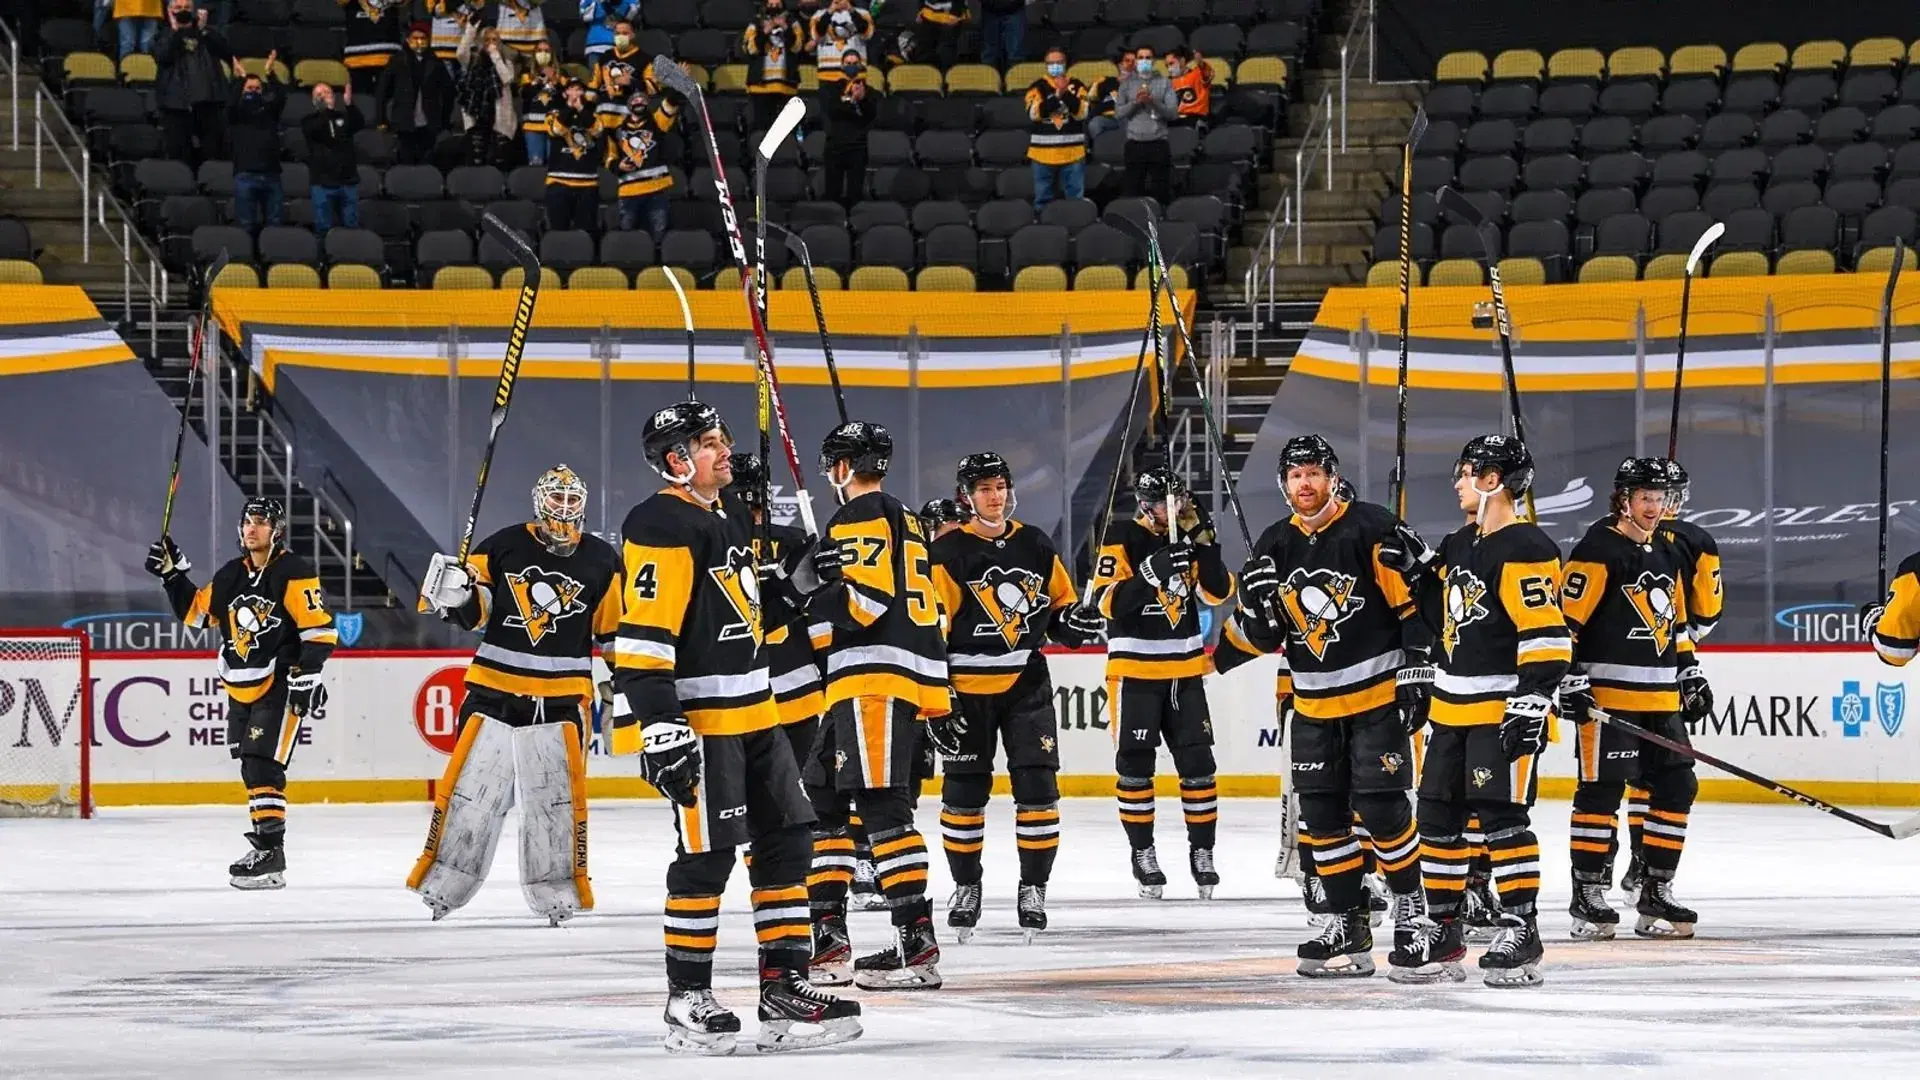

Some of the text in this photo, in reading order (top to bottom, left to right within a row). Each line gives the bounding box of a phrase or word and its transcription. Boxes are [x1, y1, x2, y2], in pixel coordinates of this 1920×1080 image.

[714, 178, 749, 267] CCM
[756, 237, 766, 310] CCM
[1490, 266, 1509, 337] BAUER
[495, 286, 535, 406] WARRIOR
[876, 458, 888, 471] 57
[1682, 500, 1919, 528] OPLES
[841, 536, 888, 568] 57
[1098, 555, 1118, 578] 8
[633, 563, 658, 600] 4
[1563, 571, 1588, 600] 9
[87, 621, 222, 650] HIGHM
[1793, 612, 1868, 642] HIGH
[189, 678, 224, 696] LIF
[424, 685, 458, 736] 8
[1689, 696, 1820, 737] MARK
[643, 729, 691, 748] CCM
[1774, 785, 1833, 813] CCM
[424, 806, 444, 852] VAUGHN
[577, 820, 588, 869] VAUGHN
